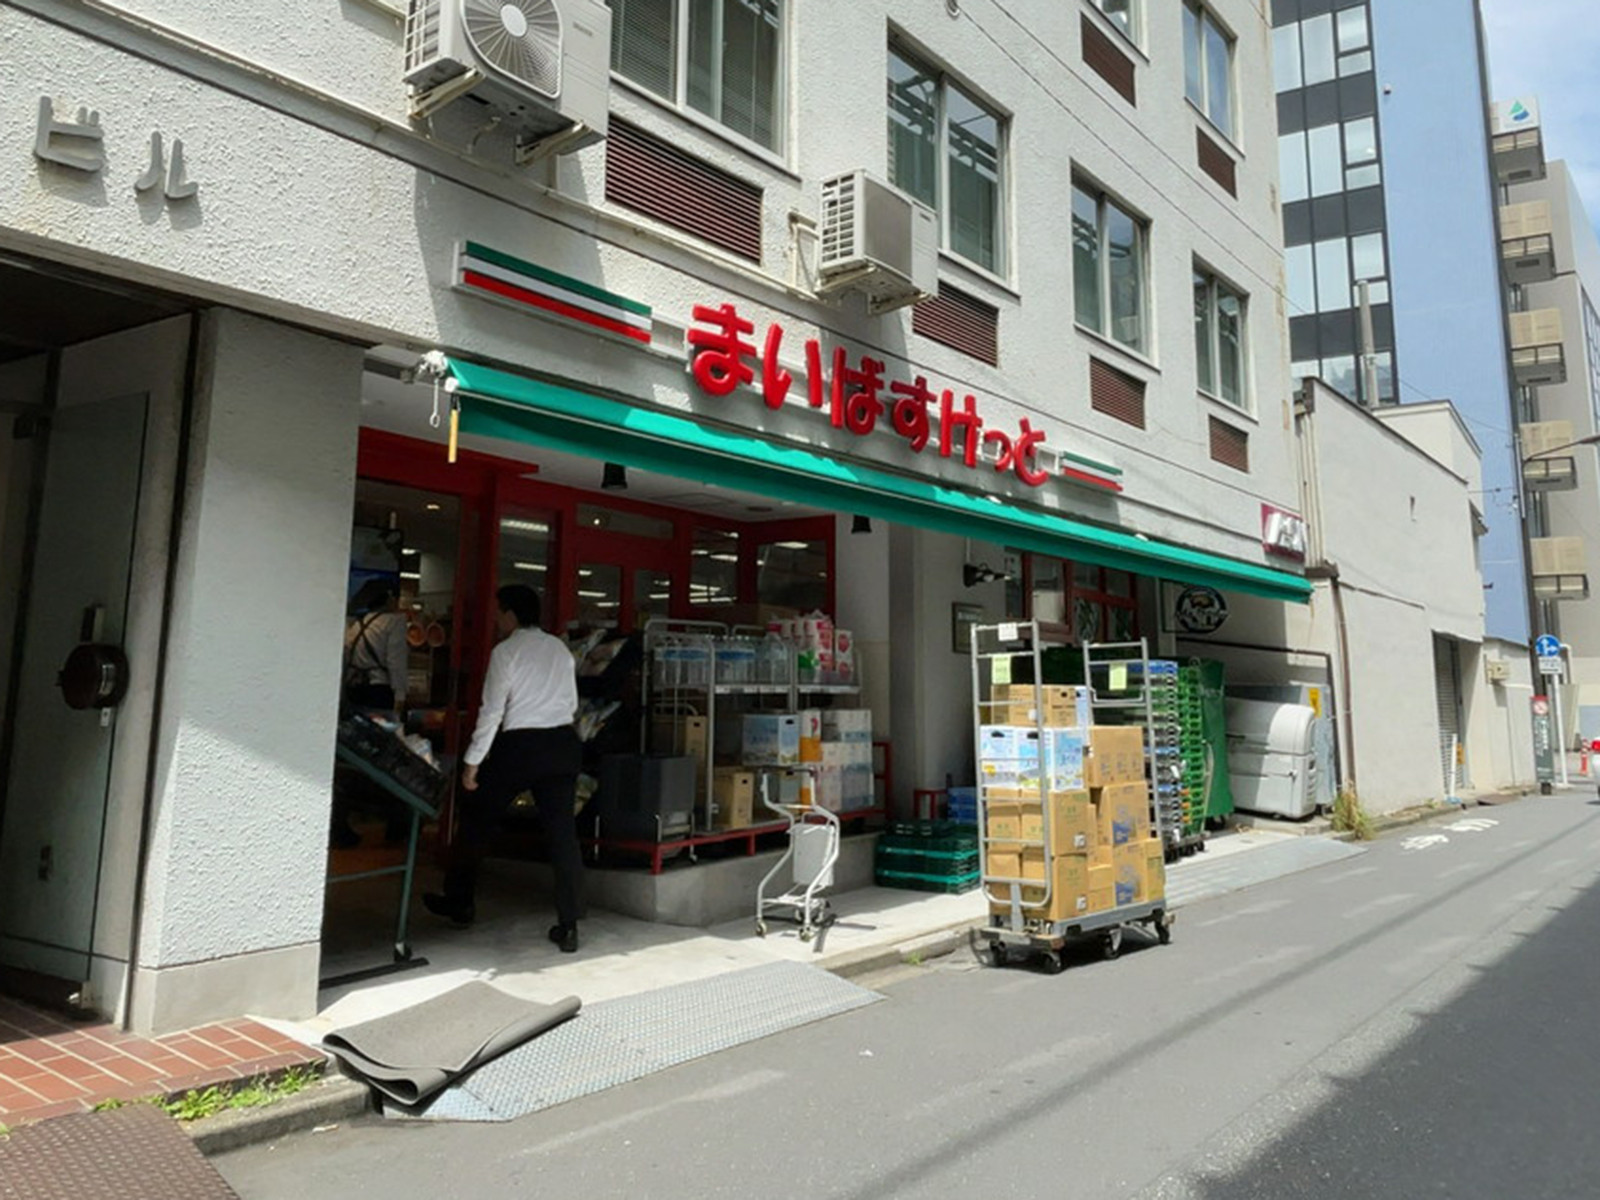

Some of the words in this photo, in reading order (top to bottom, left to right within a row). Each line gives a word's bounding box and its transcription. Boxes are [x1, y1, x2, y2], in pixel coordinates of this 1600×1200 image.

[34, 96, 198, 199] ビル
[688, 304, 1048, 486] まいばすけっと
